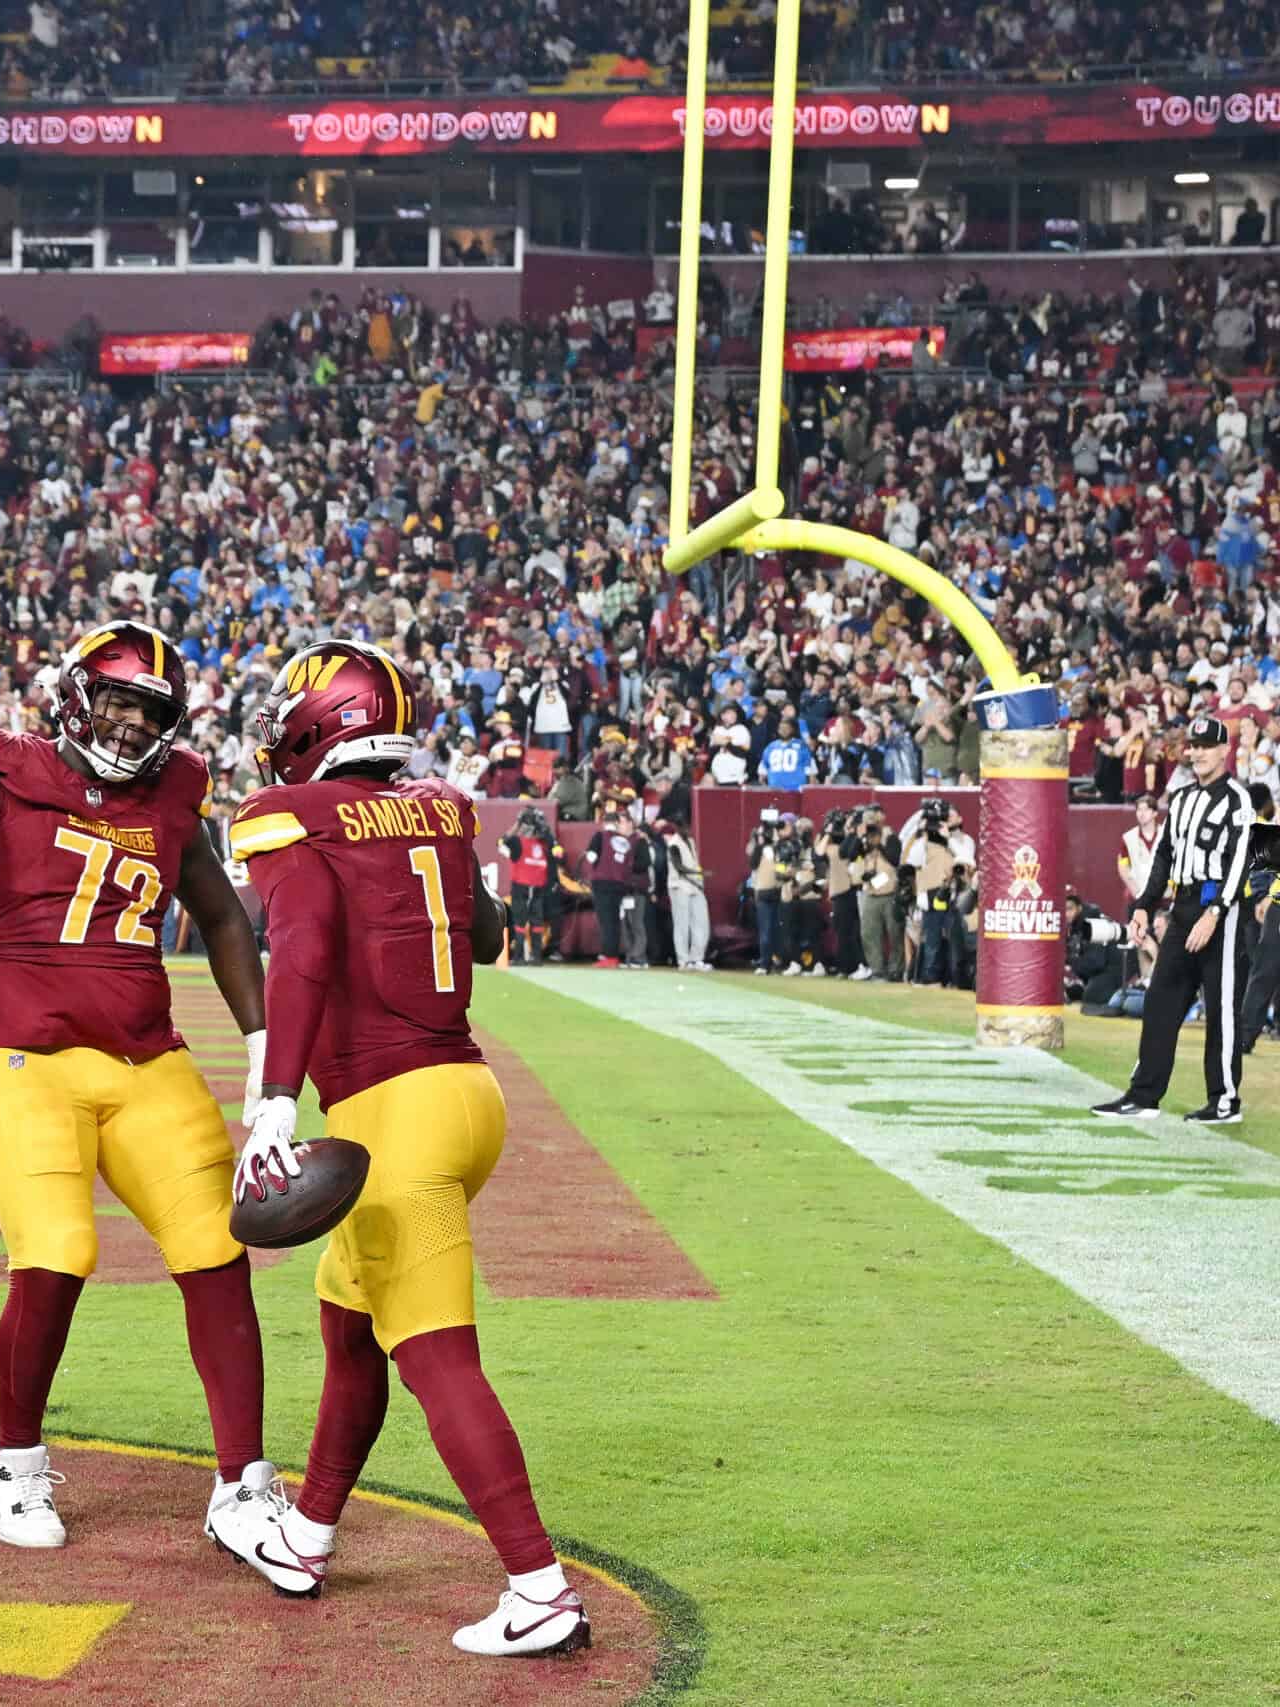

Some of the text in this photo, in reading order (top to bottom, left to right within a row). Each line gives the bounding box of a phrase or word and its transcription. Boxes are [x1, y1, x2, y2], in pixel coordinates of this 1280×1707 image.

[287, 111, 557, 143] TOUCHDOWN
[1135, 92, 1280, 127] TOUCH
[336, 798, 436, 842] SAMUEL
[54, 826, 162, 948] 72
[408, 845, 455, 993] 1
[983, 910, 1061, 934] SERVICE
[994, 899, 1039, 912] SALUTE
